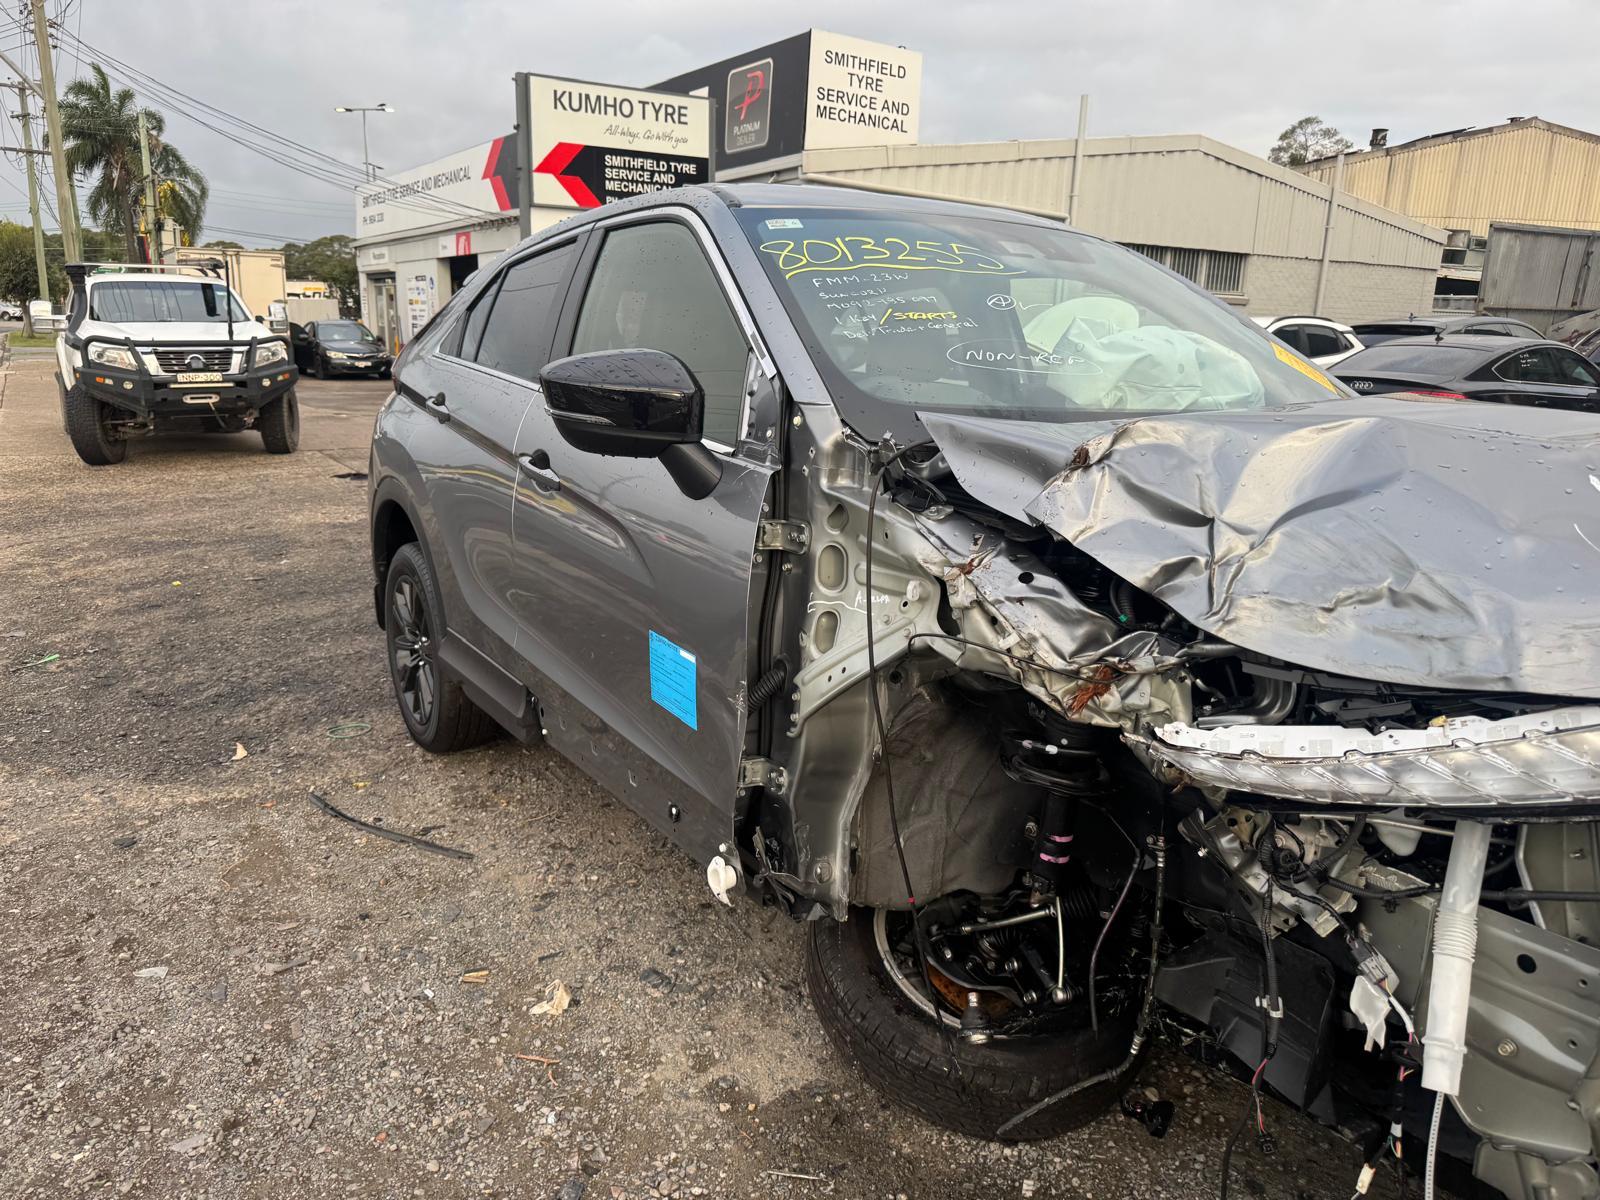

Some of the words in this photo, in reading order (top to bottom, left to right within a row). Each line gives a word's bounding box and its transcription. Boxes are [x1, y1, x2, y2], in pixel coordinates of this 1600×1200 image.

[824, 50, 907, 79] SMITHFIELD
[847, 72, 884, 93] TYRE
[553, 89, 634, 119] KUMHO
[638, 100, 689, 125] TYRE
[816, 87, 877, 111] SERVICE
[881, 99, 910, 116] AND
[816, 104, 908, 134] MECHANICAL
[421, 176, 432, 192] AND
[433, 166, 471, 189] MECHANICAL
[604, 154, 668, 172] SMITHFIELD
[669, 162, 697, 175] TYRE
[604, 168, 653, 182] SERVICE
[653, 173, 676, 184] AND
[760, 237, 1004, 269] 8013255
